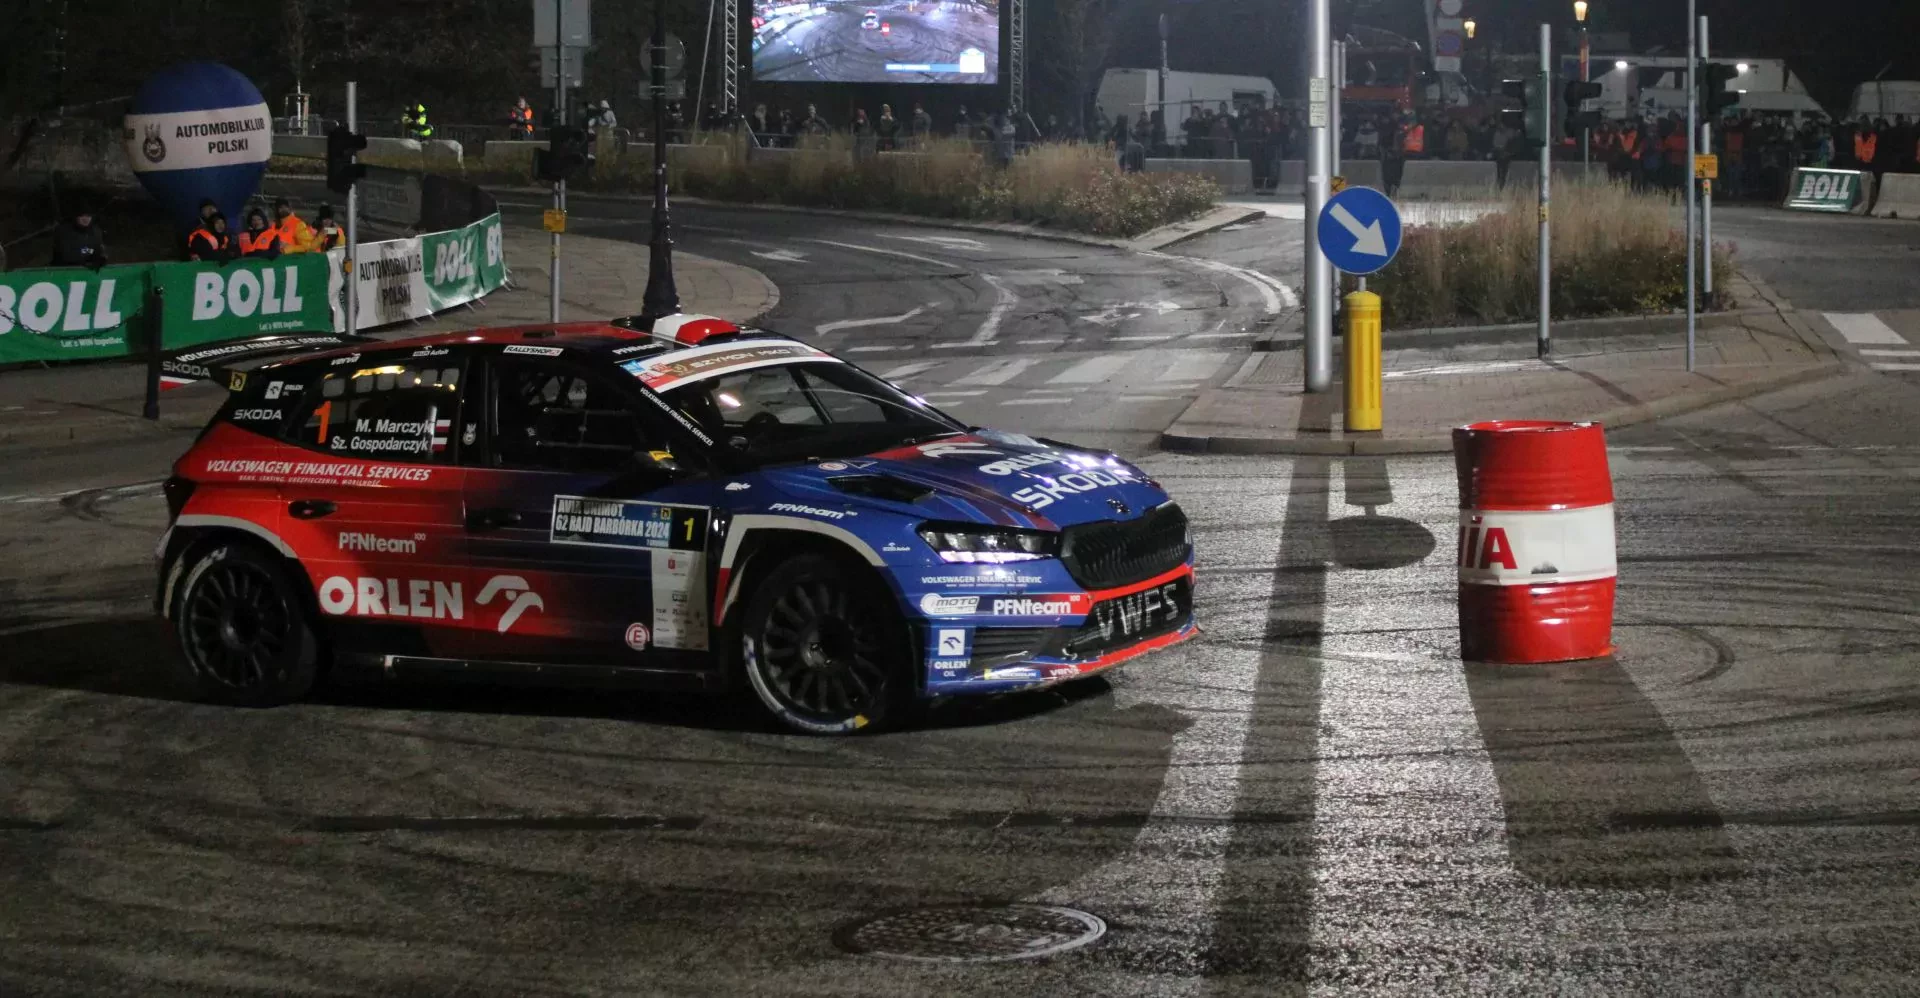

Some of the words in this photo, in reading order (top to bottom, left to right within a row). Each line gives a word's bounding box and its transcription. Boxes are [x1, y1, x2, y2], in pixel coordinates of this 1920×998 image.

[176, 117, 265, 138] AUTOMOBILKLUB
[208, 138, 249, 154] POLSKI
[1798, 174, 1851, 200] BOLL
[433, 237, 475, 286] BOLL
[192, 265, 303, 321] BOLL
[175, 344, 249, 363] VOLKSWAGEN
[247, 339, 300, 352] FINANCIAL
[312, 400, 331, 444] 1
[355, 419, 372, 433] M.
[640, 387, 671, 412] VOLKSWAGEN
[668, 409, 693, 430] FINANCIAL
[691, 427, 714, 446] SERVICES
[331, 435, 348, 450] Sz.
[350, 436, 429, 453] Gospodarczyk
[206, 459, 293, 474] VOLKSWAGEN
[294, 462, 364, 477] FINANCIAL
[366, 465, 432, 481] SERVICES
[769, 502, 845, 520] PFNteam
[555, 513, 569, 531] 62
[569, 516, 593, 533] RAJD
[593, 514, 644, 537] BARBÓRKA
[645, 521, 670, 538] 2024
[683, 517, 695, 541] 1
[338, 531, 417, 554] PFNteam
[921, 576, 975, 584] VOLKSWAGEN
[976, 575, 1016, 583] FINANCIAL
[319, 575, 464, 620] ORLEN
[936, 597, 978, 607] MOTO
[993, 598, 1072, 616] PFNteam
[633, 629, 642, 644] E
[933, 660, 967, 670] ORLEN
[943, 670, 957, 678] OIL
